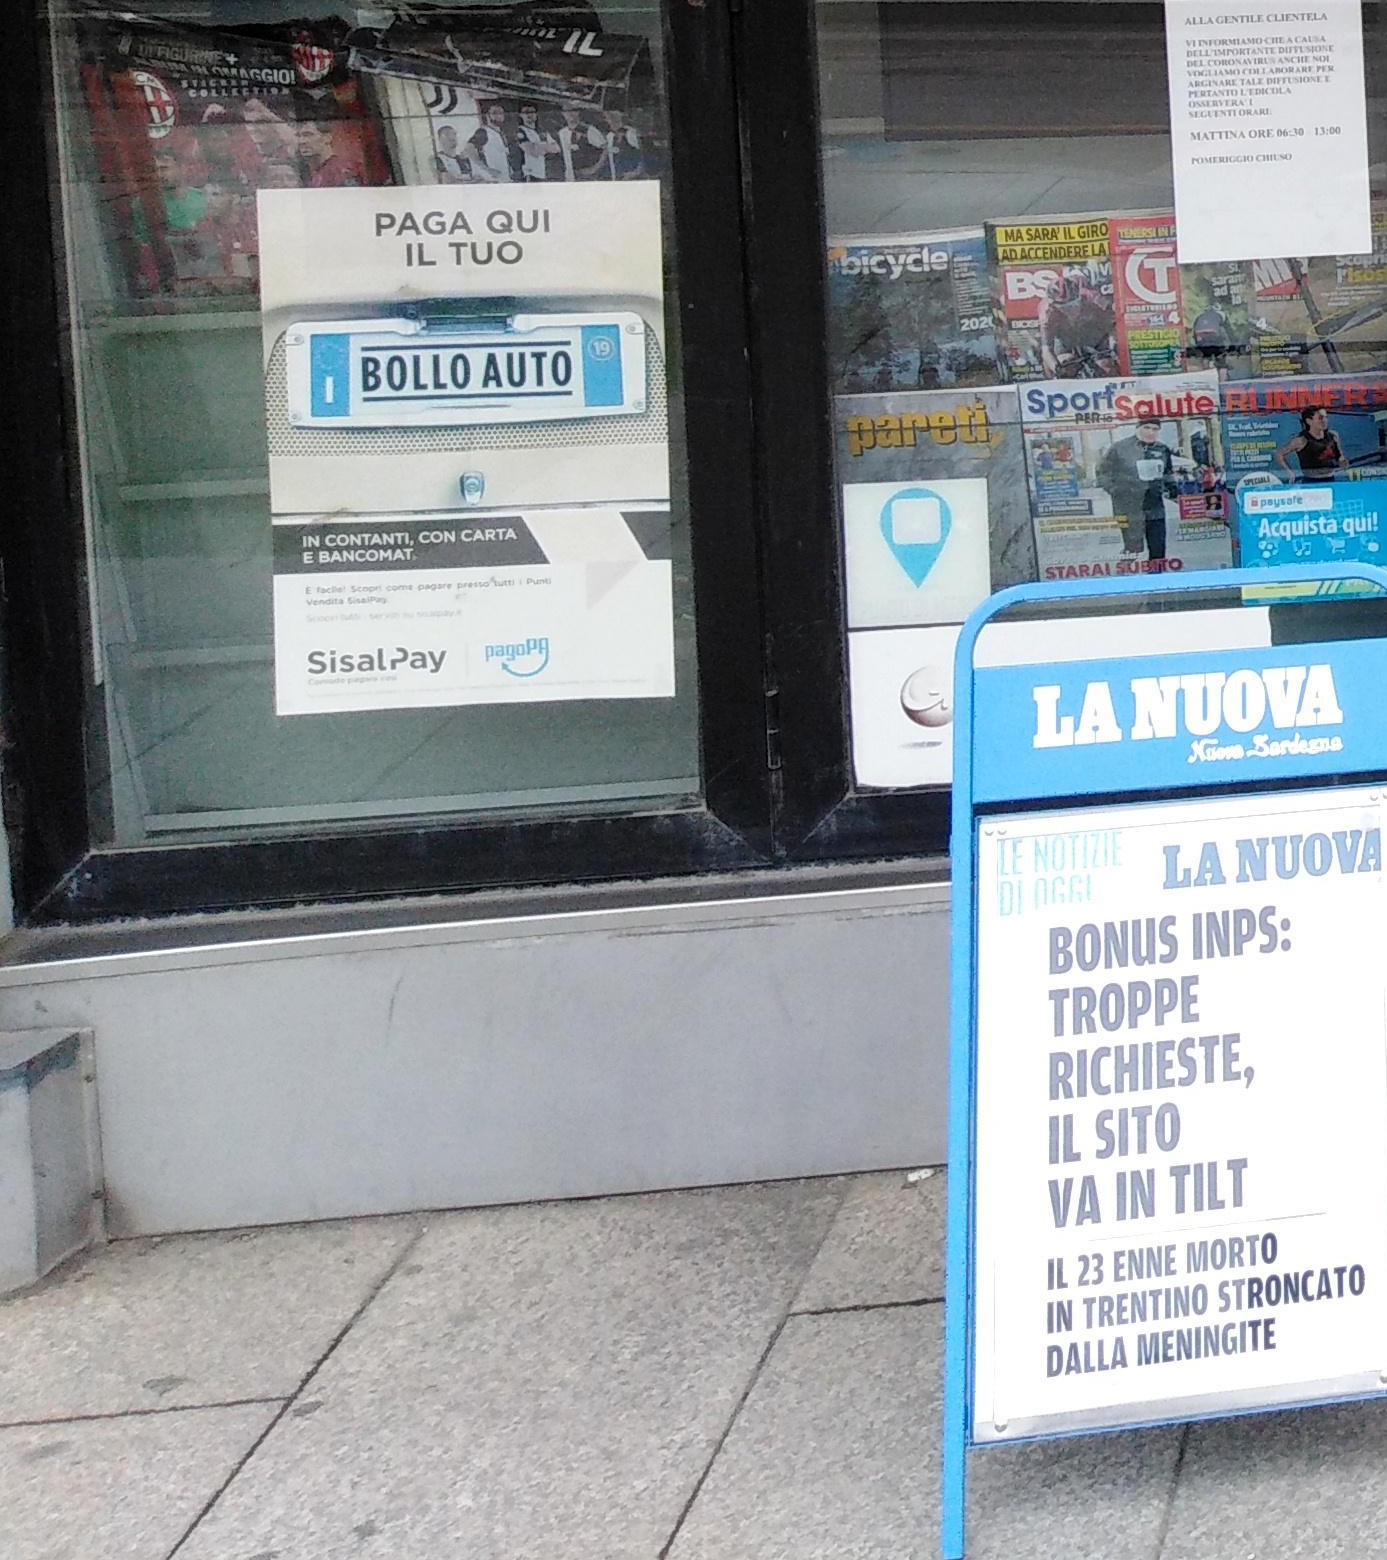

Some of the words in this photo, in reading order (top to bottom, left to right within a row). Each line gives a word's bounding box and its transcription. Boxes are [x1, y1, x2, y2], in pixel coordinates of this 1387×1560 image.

[1185, 16, 1214, 26] ALLA
[1215, 14, 1265, 25] GENTILE
[1266, 12, 1329, 24] CLIENTELA
[1190, 129, 1247, 142] MATTINA
[1248, 128, 1275, 140] ORE
[1313, 125, 1342, 137] 13:00
[374, 209, 473, 238] PAGA
[486, 208, 552, 237] QUI
[1003, 228, 1024, 243] MA
[1063, 226, 1076, 239] IL
[1077, 222, 1109, 238] GIRO
[405, 243, 438, 268] IL
[447, 241, 525, 267] TUO
[840, 246, 949, 280] bicycle
[1001, 247, 1019, 262] AD
[1019, 243, 1090, 260] ACCENDERE
[1091, 242, 1107, 257] LA
[361, 351, 473, 393] BOLLO
[482, 348, 574, 389] AUTO
[1027, 382, 1115, 417] Sport
[1113, 391, 1215, 422] Salute
[847, 401, 991, 457] pareti
[303, 535, 320, 548] IN
[324, 532, 415, 549] CONTANTI,
[418, 530, 458, 545] CON
[460, 527, 518, 543] CARTA
[1258, 513, 1338, 540] Acquista
[1341, 511, 1379, 538] qui!
[303, 551, 314, 565] E
[318, 547, 416, 564] BANCOMAT.
[1045, 562, 1111, 580] STARAI
[1116, 557, 1184, 575] SUBITO
[306, 646, 448, 675] SisalPay
[1032, 680, 1123, 749] LA
[1130, 663, 1344, 740] NUOVA
[1161, 842, 1227, 890] LA
[1235, 827, 1382, 884] NUOVA
[1048, 915, 1178, 975] BONUS
[1192, 905, 1293, 961] INPS:
[1048, 974, 1201, 1038] TROPPE
[1048, 1032, 1256, 1101] RICHIESTE,
[1048, 1113, 1082, 1165] IL
[1094, 1102, 1182, 1160] SITO
[1047, 1174, 1102, 1229] VA
[1115, 1167, 1157, 1222] IN
[1168, 1157, 1250, 1214] TILT
[1046, 1256, 1070, 1291] IL
[1077, 1253, 1106, 1288] 23
[1112, 1243, 1178, 1283] ENNE
[1186, 1232, 1280, 1274] MORTO
[1046, 1300, 1074, 1335] IN
[1083, 1282, 1209, 1330] TRENTINO
[1218, 1263, 1367, 1312] STRONCATO
[1045, 1334, 1129, 1379] DALLA
[1136, 1316, 1278, 1367] MENINGITE
